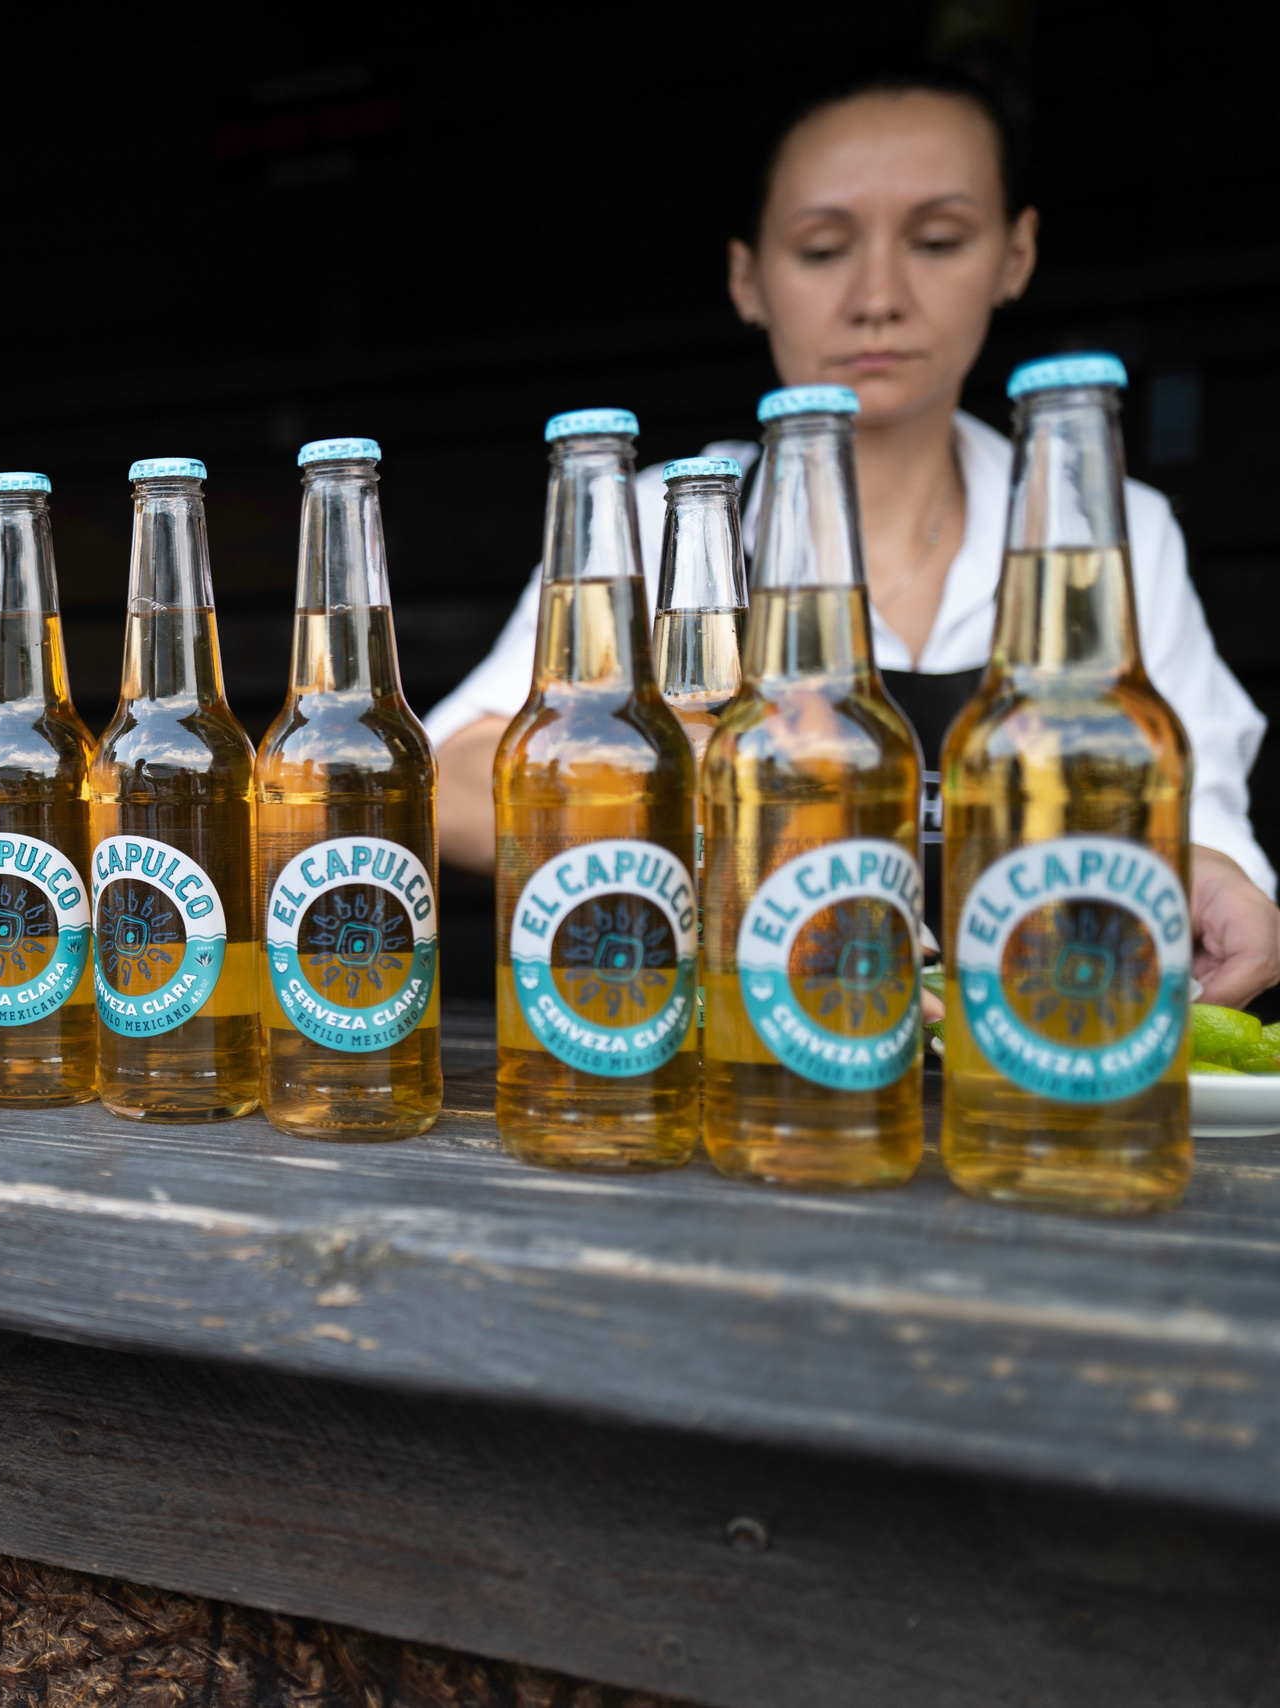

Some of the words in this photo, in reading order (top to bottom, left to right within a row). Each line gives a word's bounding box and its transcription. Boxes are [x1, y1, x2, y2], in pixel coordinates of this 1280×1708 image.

[96, 843, 214, 919] CAPULCO
[273, 885, 307, 928] EL
[300, 845, 431, 922] CAPULCO
[521, 893, 561, 939] EL
[555, 850, 695, 934] CAPULCO
[751, 898, 801, 946] EL
[795, 851, 922, 936] CAPULC
[968, 895, 1013, 946] EL
[1007, 850, 1184, 945] CAPULCO
[0, 990, 64, 1020] MEXICANO
[17, 961, 68, 1004] CLARA
[94, 964, 137, 1016] CERVEZA
[142, 972, 198, 1015] CLARA
[281, 989, 294, 1008] 400
[288, 978, 368, 1031] CERVEZA
[373, 977, 422, 1027] CLARA
[96, 997, 120, 1027] STILO
[125, 1003, 191, 1032] MEXICANO
[297, 1011, 343, 1044] ESTILO
[351, 1010, 418, 1047] MEXICANO
[537, 994, 629, 1054] CERVEZA
[633, 996, 686, 1049] CLARA
